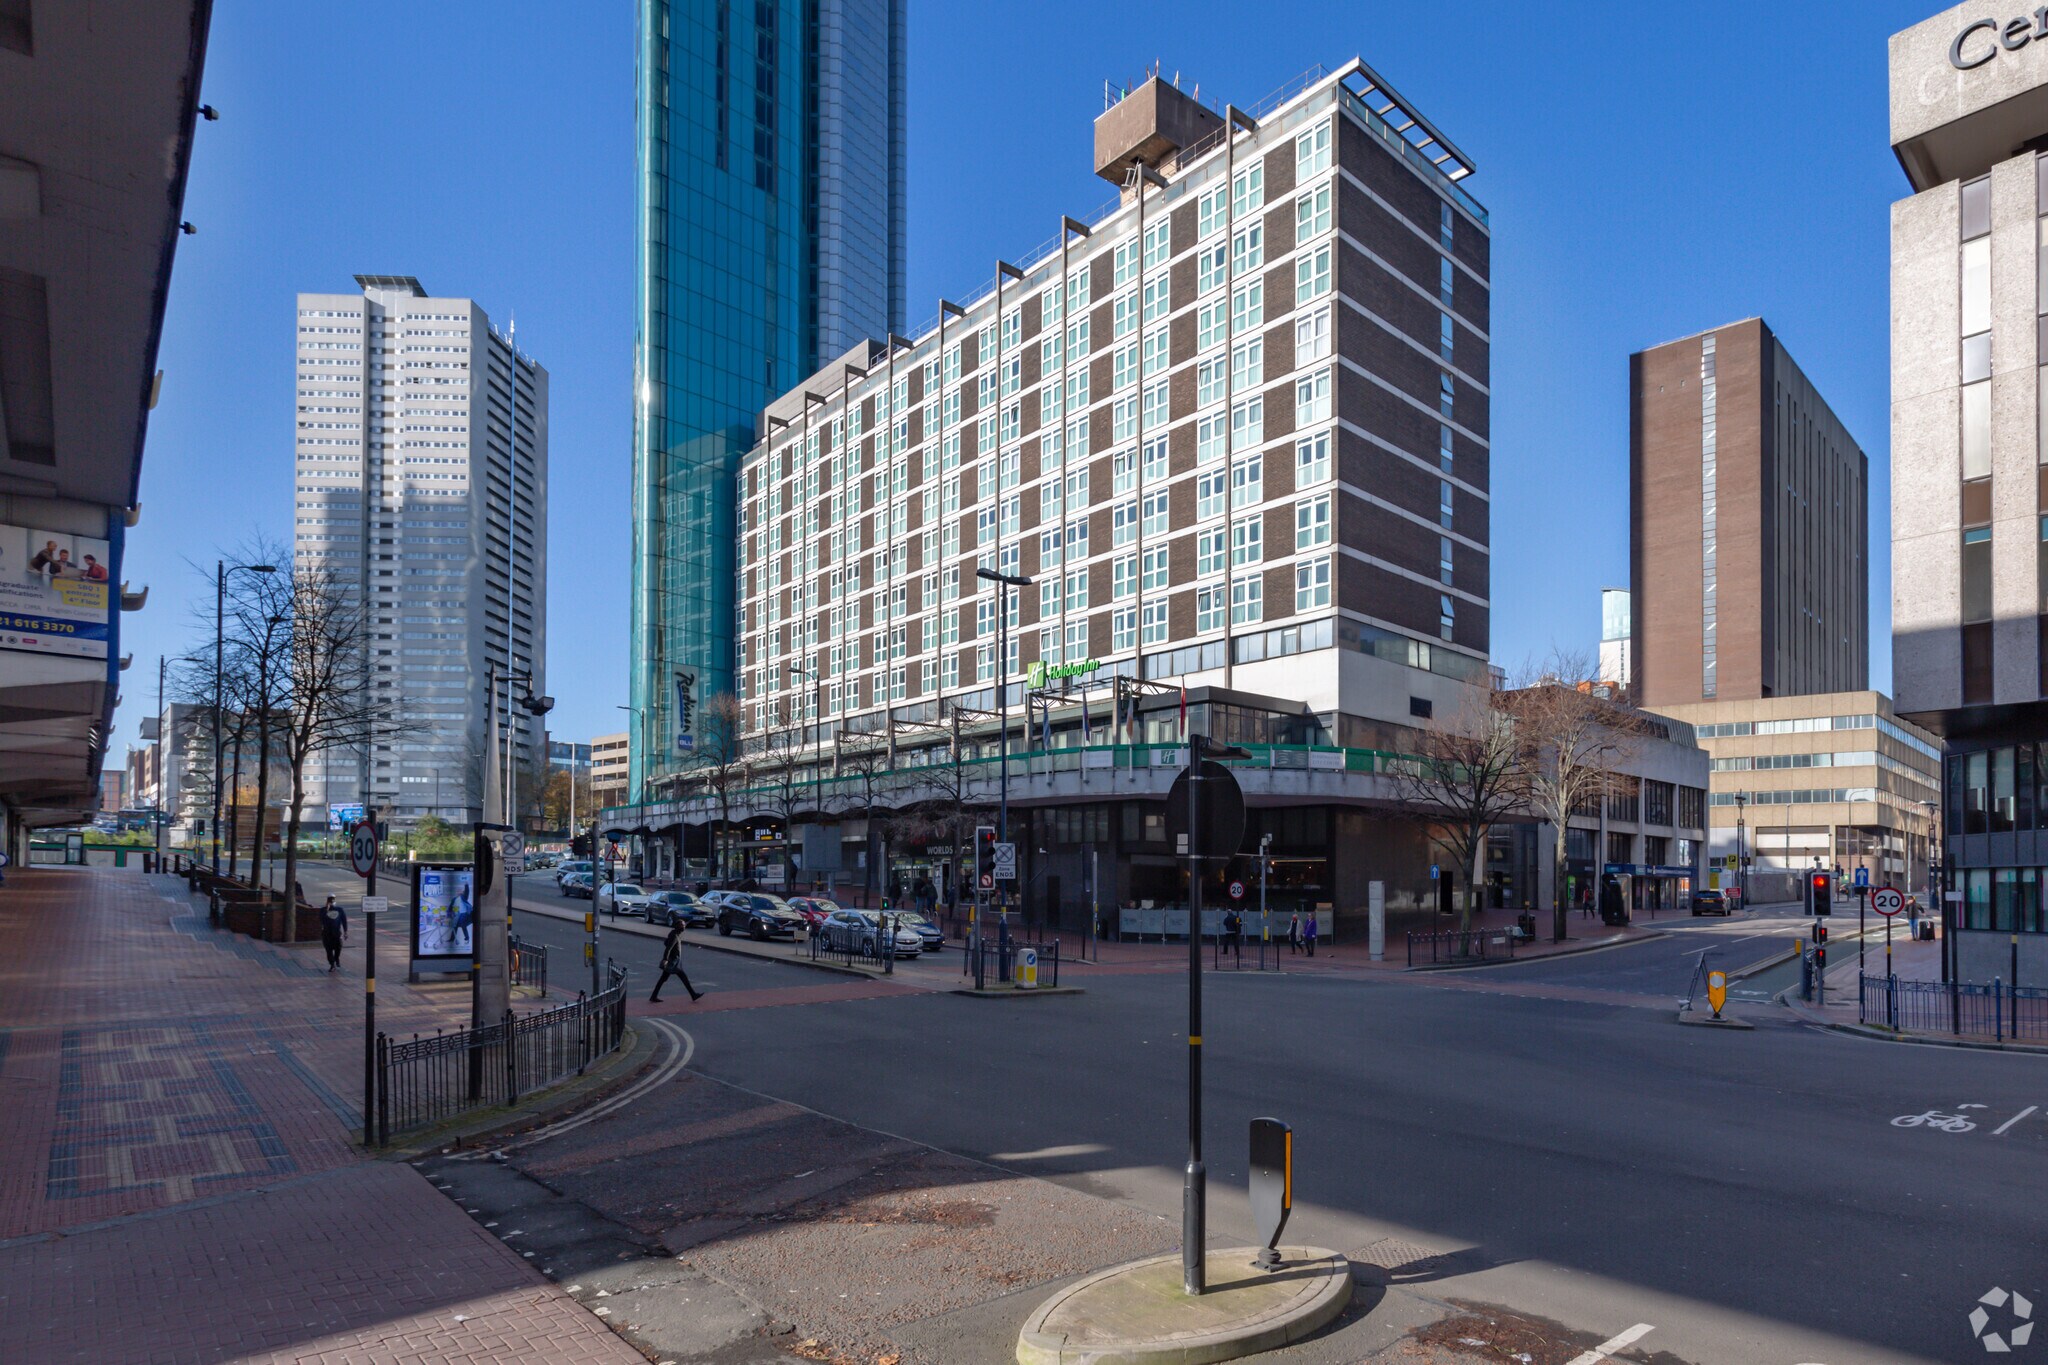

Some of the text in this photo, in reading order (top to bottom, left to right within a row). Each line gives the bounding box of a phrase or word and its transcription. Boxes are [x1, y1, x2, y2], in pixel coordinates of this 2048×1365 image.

[66, 590, 100, 598] entrance
[14, 619, 40, 629] 616
[43, 622, 75, 633] 3370
[1049, 658, 1101, 680] Holiday Inn
[674, 671, 697, 734] Radisson
[354, 837, 374, 861] 30
[926, 845, 954, 855] WORLDS
[1231, 886, 1243, 894] 20
[1877, 895, 1901, 908] 20
